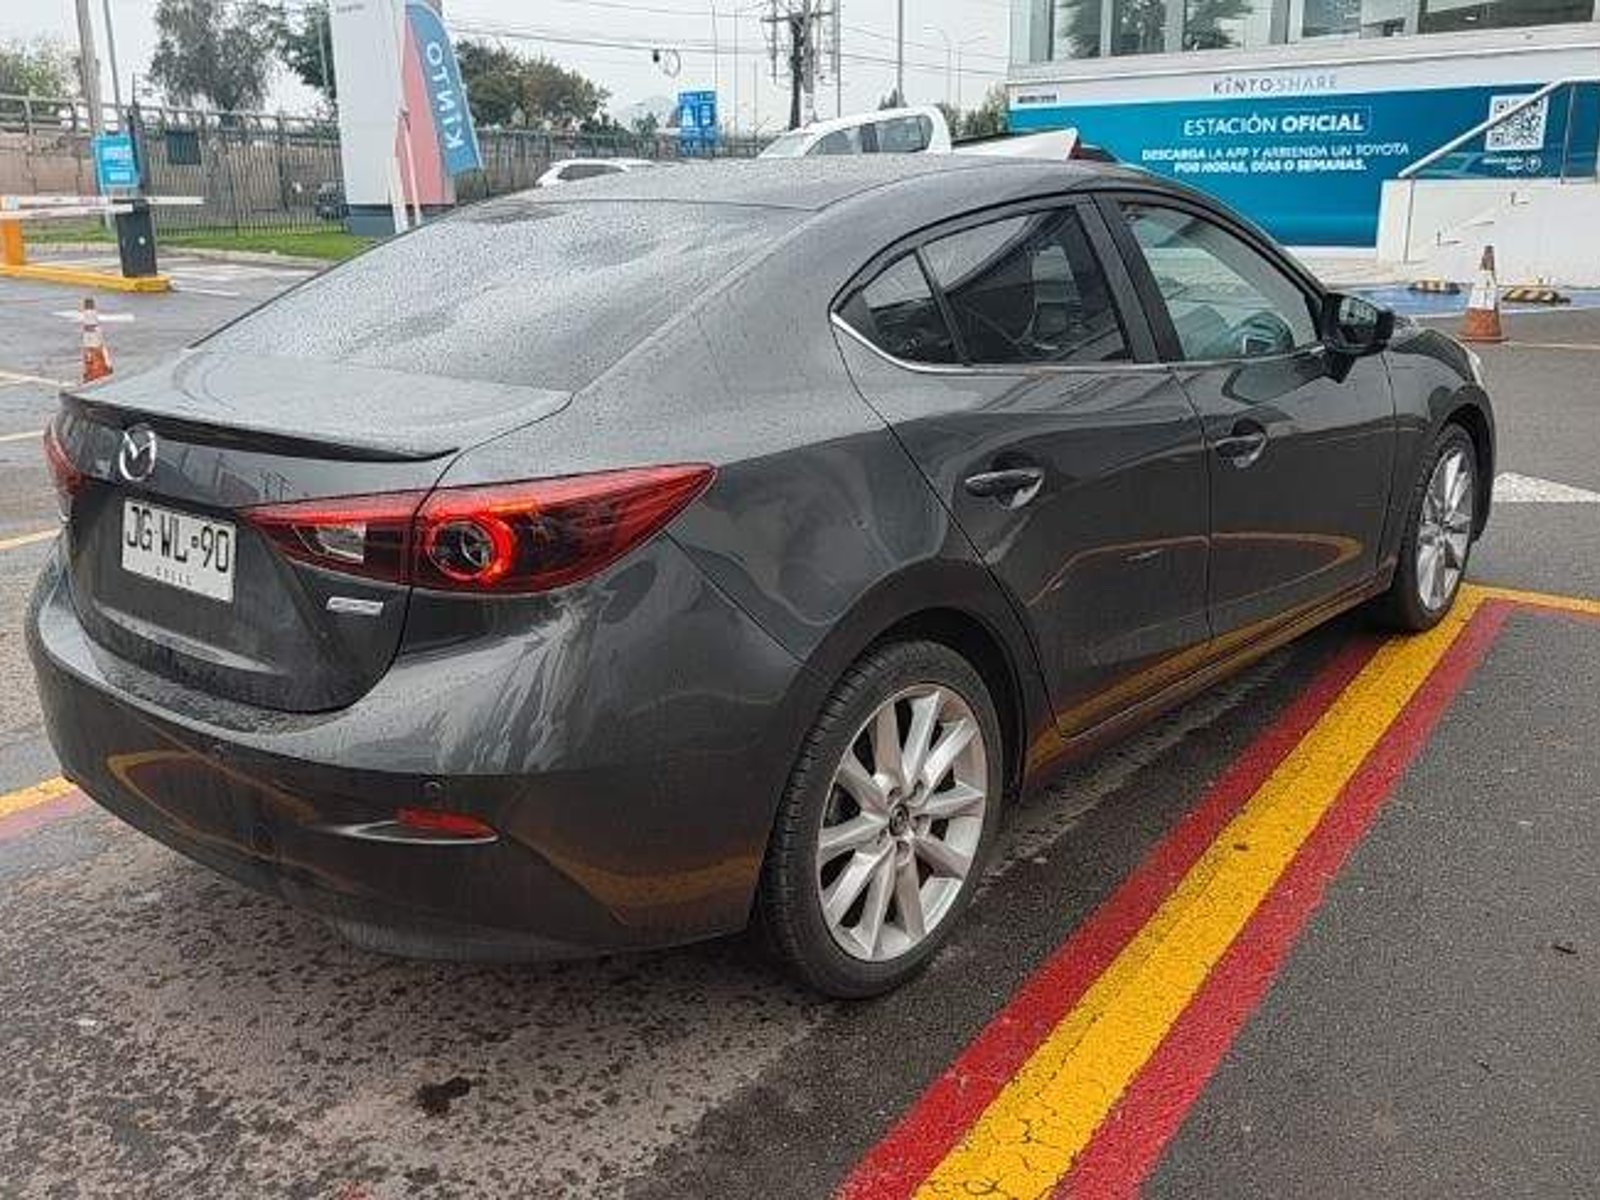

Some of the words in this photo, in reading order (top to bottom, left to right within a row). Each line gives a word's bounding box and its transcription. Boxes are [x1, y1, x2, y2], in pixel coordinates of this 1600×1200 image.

[1183, 112, 1276, 136] ESTACIÓN
[1281, 112, 1365, 133] OFICIAL
[1142, 148, 1206, 160] DESCARGA
[1208, 147, 1223, 160] LA
[1225, 147, 1250, 159] APP
[1251, 147, 1262, 158] Y
[1331, 145, 1353, 157] UN
[1355, 142, 1409, 156] TOYOTA
[1174, 161, 1200, 173] POR
[1283, 159, 1295, 172] O
